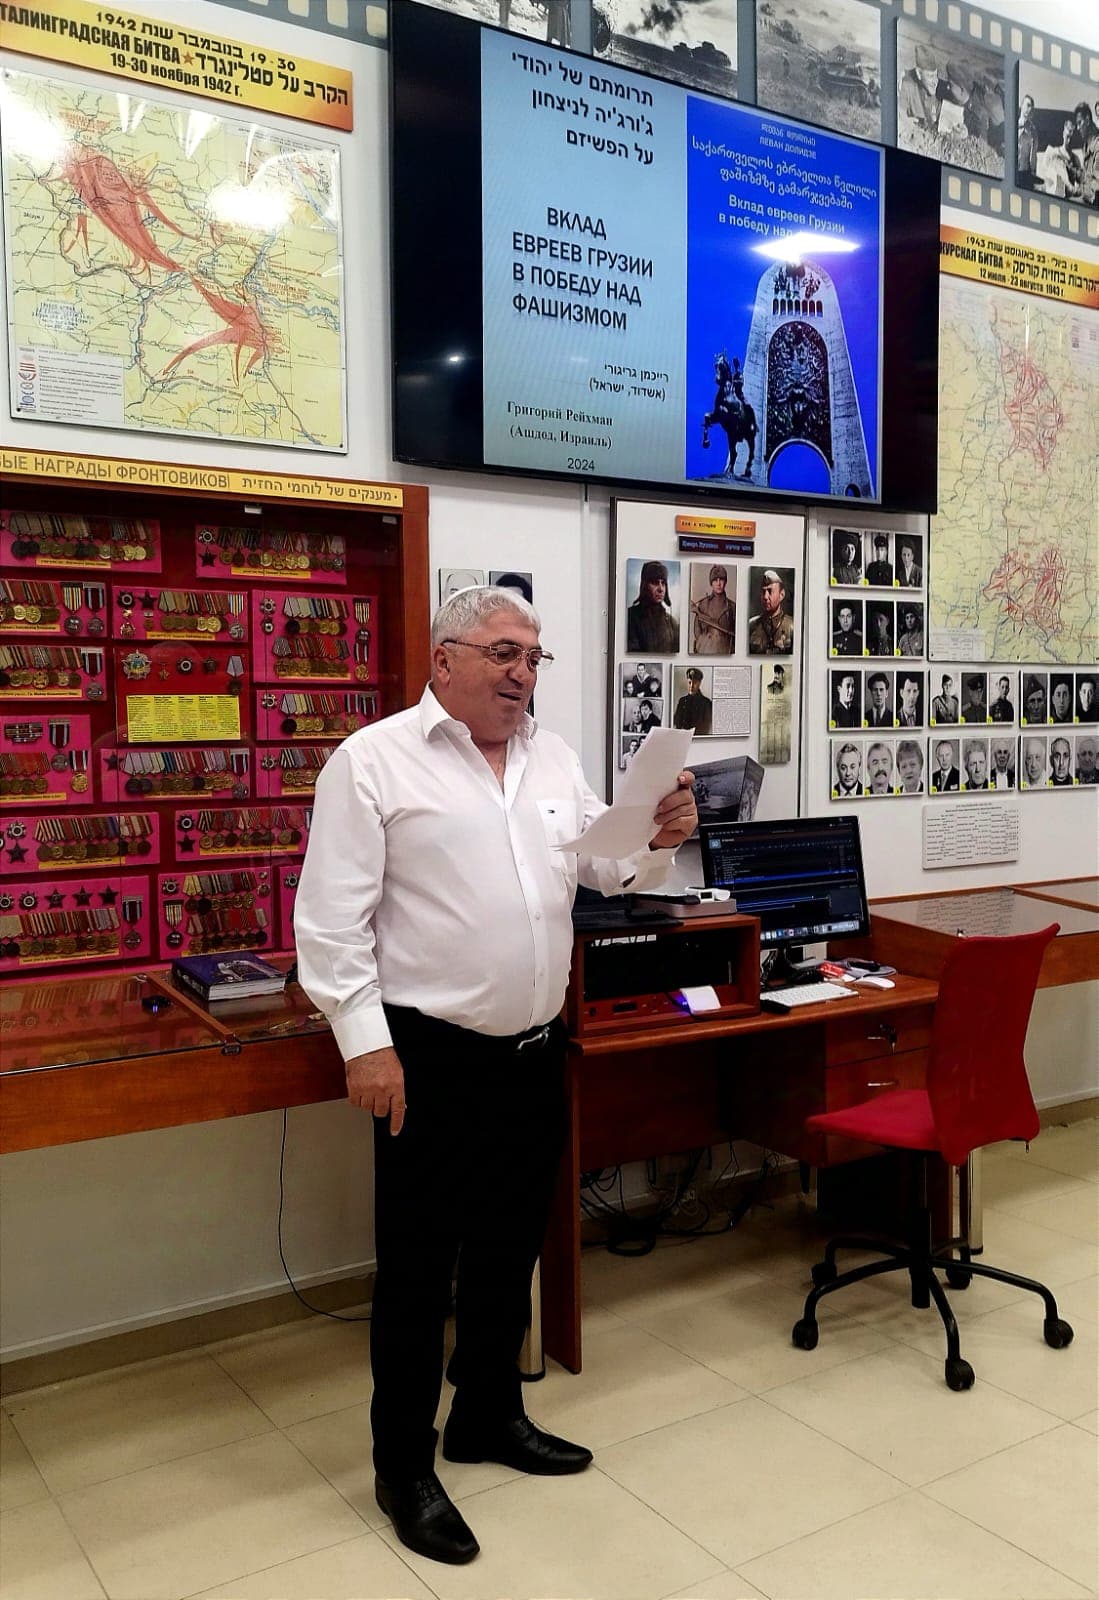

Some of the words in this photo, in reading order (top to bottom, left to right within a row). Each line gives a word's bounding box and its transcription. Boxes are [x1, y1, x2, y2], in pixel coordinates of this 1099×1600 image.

[97, 12, 137, 31] 1942
[140, 22, 173, 40] שנת
[134, 36, 181, 64] БИТВА
[178, 32, 244, 59] בנובמבר
[110, 52, 148, 74] 19-30
[151, 64, 200, 87] ноября
[202, 75, 232, 95] 1942
[195, 52, 273, 87] סטלינגרד
[512, 52, 552, 75] יהודי
[559, 61, 583, 85] של
[278, 71, 300, 93] על
[304, 80, 348, 106] הקרב
[589, 75, 653, 107] תרומתם
[532, 89, 589, 117] לניצחון
[595, 107, 653, 136] ג'ורג'יה
[566, 129, 629, 158] הפשיזם
[634, 143, 653, 165] על
[692, 135, 773, 170] საქართველოს
[547, 206, 607, 240] ВКЛАД
[719, 213, 726, 223] в
[729, 214, 770, 235] победу
[729, 194, 764, 216] Вклад
[767, 205, 806, 224] евреев
[808, 216, 845, 233] Грузии
[966, 236, 986, 248] 1943
[513, 231, 582, 263] ЕВРЕЕВ
[588, 247, 653, 278] ГРУЗИИ
[978, 250, 1004, 269] БИТВА
[980, 267, 986, 279] 12
[1013, 260, 1040, 279] קורסק
[1042, 267, 1066, 284] בחזית
[513, 262, 525, 281] В
[531, 266, 601, 297] ПОБЕДУ
[606, 280, 642, 307] НАД
[513, 293, 627, 330] ФАШИЗМОМ
[604, 363, 637, 379] גריגורי
[641, 369, 669, 384] רייכמן
[589, 377, 625, 394] ישראל)
[507, 400, 562, 420] Григорий
[566, 409, 613, 427] Рейхман
[510, 425, 557, 442] (Ашдод,
[560, 431, 612, 449] Израиль)
[0, 454, 28, 470] ЫЕ
[35, 457, 111, 478] НАГРАДЫ
[116, 465, 227, 488] ФРОНТОВИКОВ
[567, 457, 595, 471] 2024
[242, 477, 282, 491] החזית
[288, 482, 322, 495] לוחמי
[327, 484, 344, 497] של
[349, 487, 391, 502] מענקים
